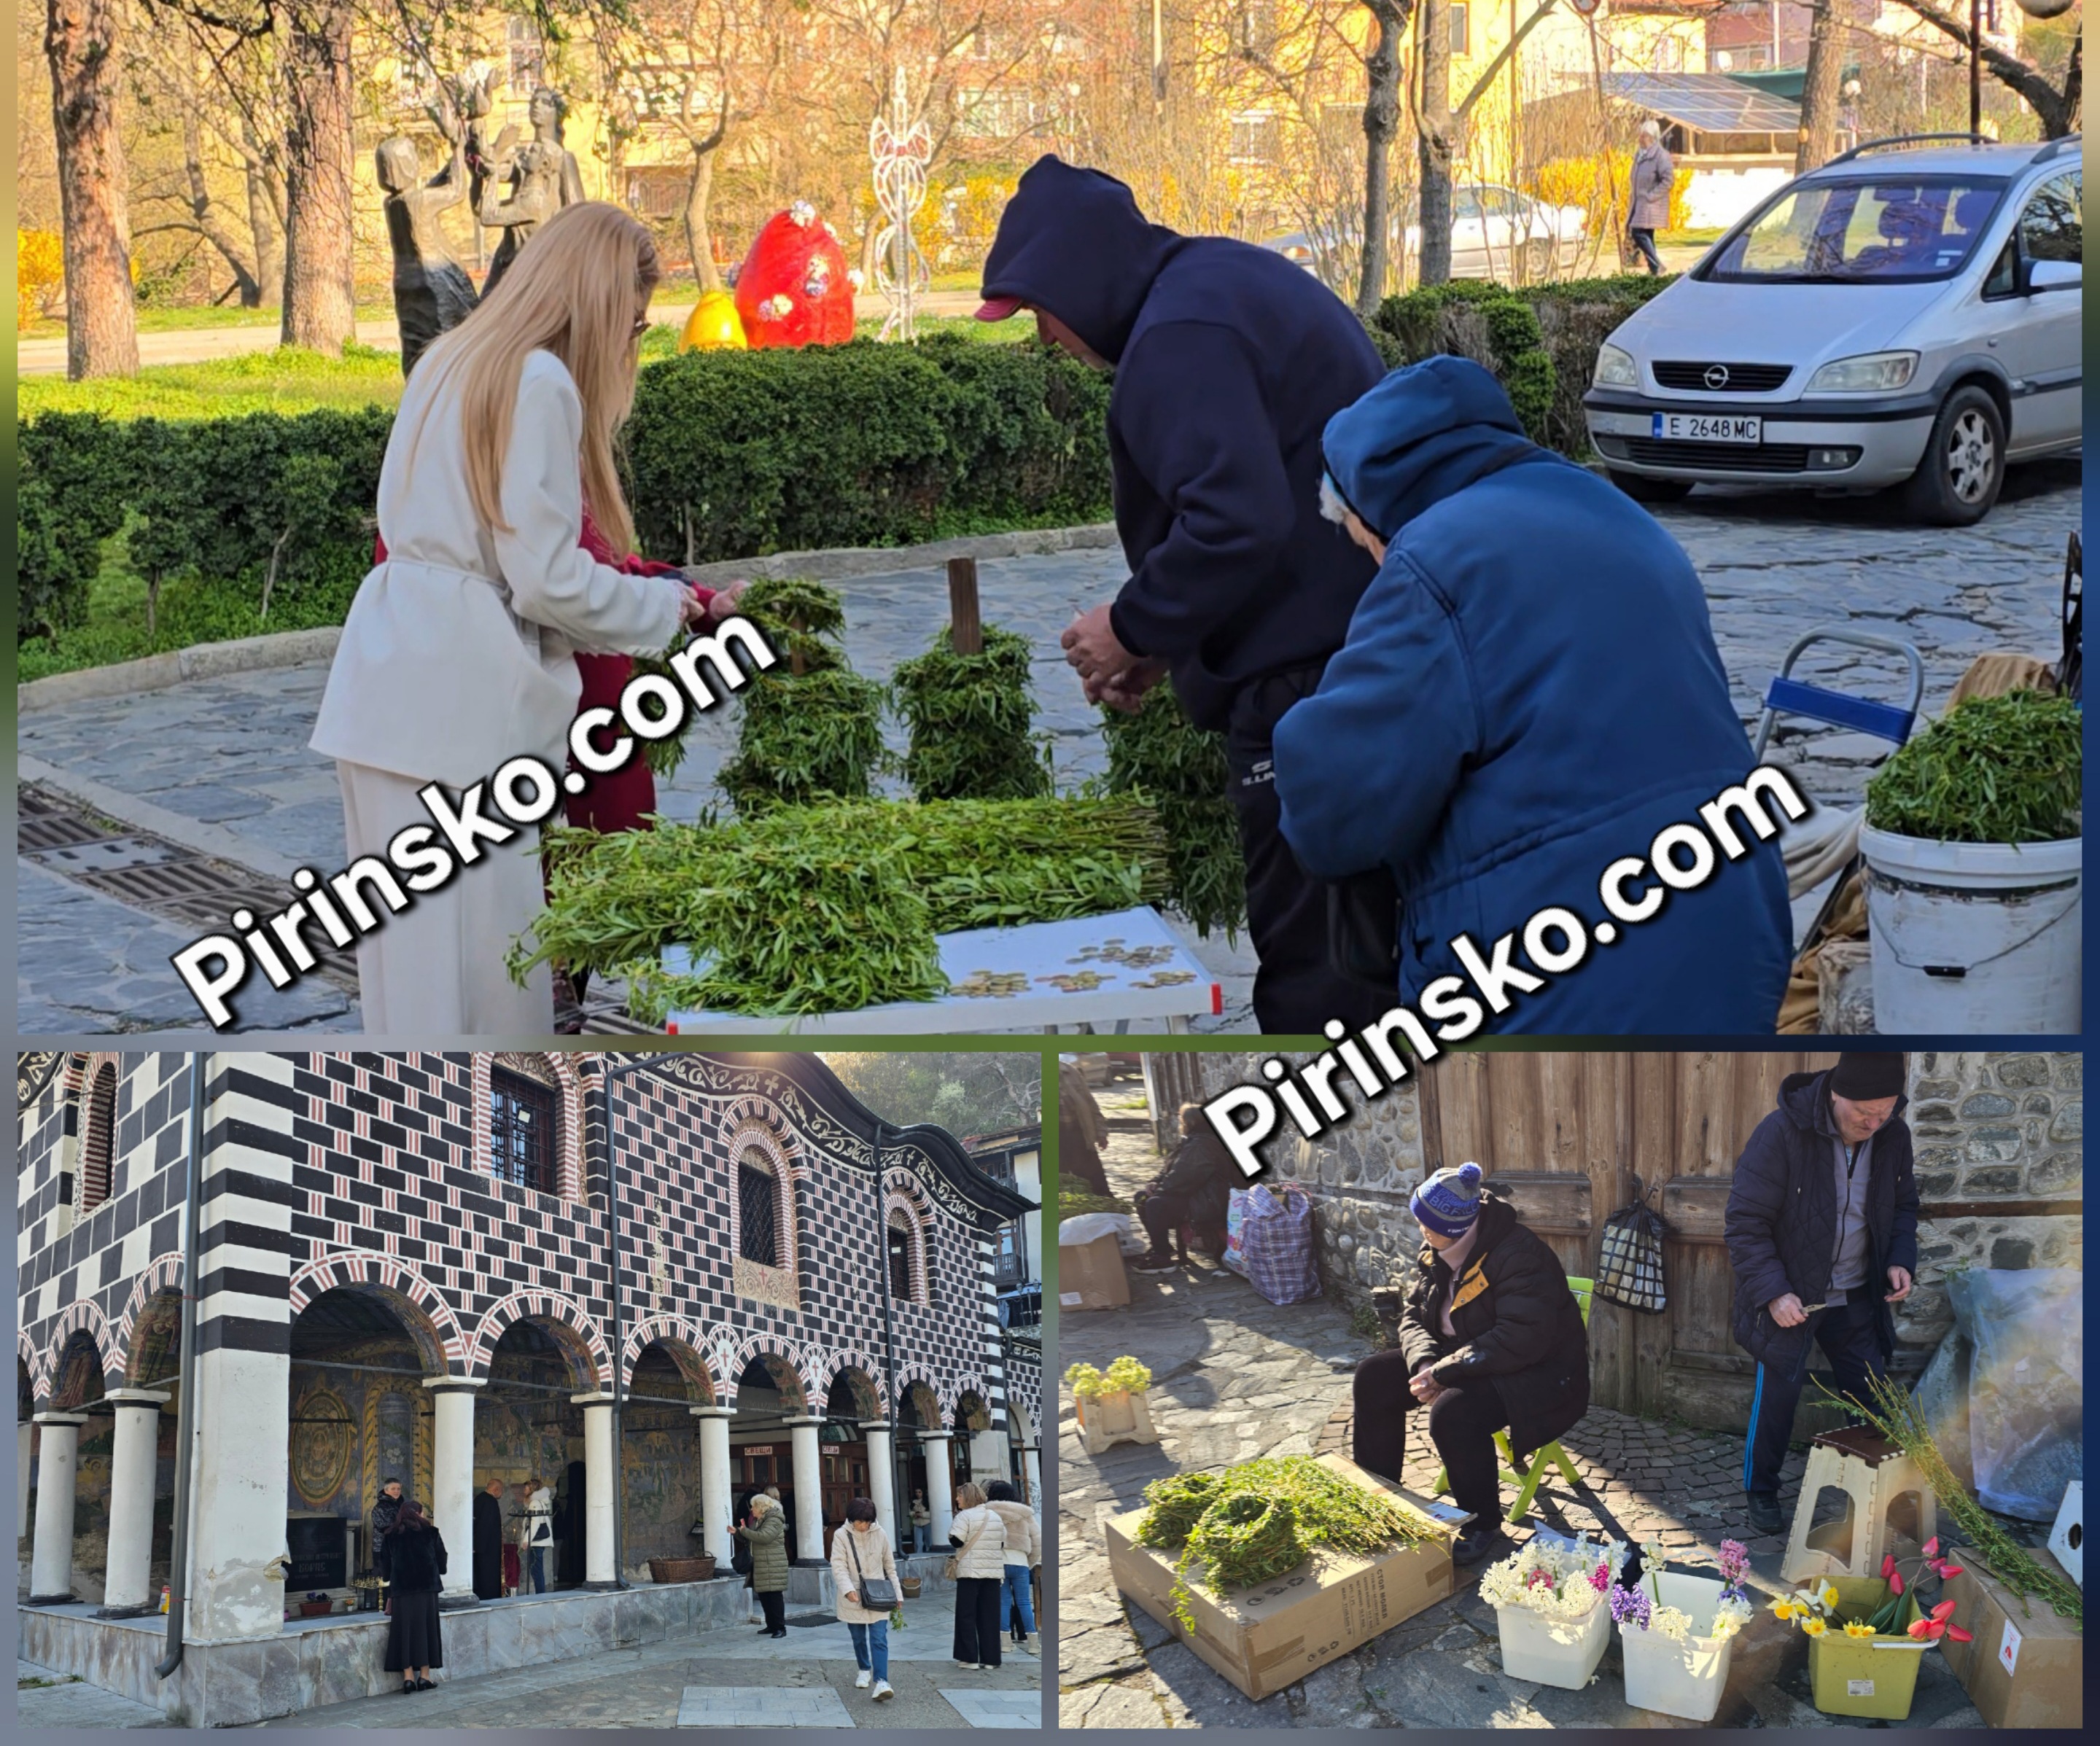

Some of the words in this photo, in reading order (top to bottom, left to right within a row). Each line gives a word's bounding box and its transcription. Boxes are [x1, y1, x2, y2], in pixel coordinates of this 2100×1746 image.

[1670, 418, 1680, 435] E
[1689, 418, 1730, 437] 2648
[1734, 422, 1757, 440] MC
[1429, 1196, 1450, 1212] BIG
